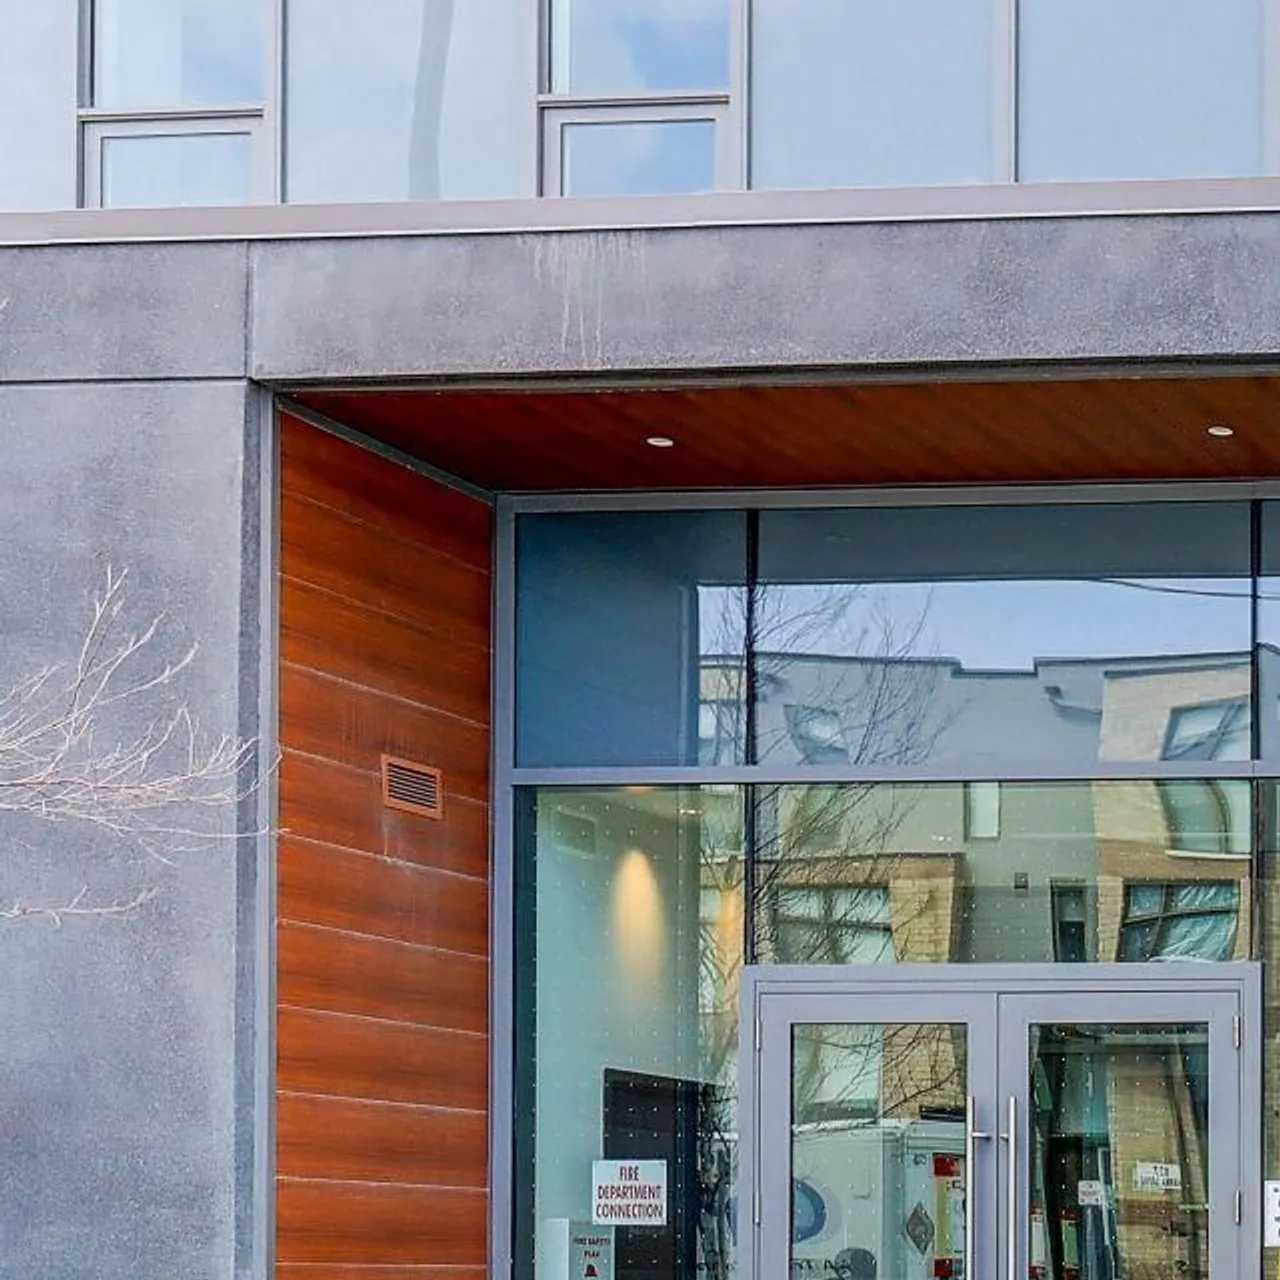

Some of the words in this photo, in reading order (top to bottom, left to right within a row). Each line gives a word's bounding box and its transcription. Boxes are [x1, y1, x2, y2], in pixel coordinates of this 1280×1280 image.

[620, 1166, 639, 1181] FIRE
[598, 1185, 662, 1199] DEPARTMENT
[596, 1204, 663, 1218] CONNECTION
